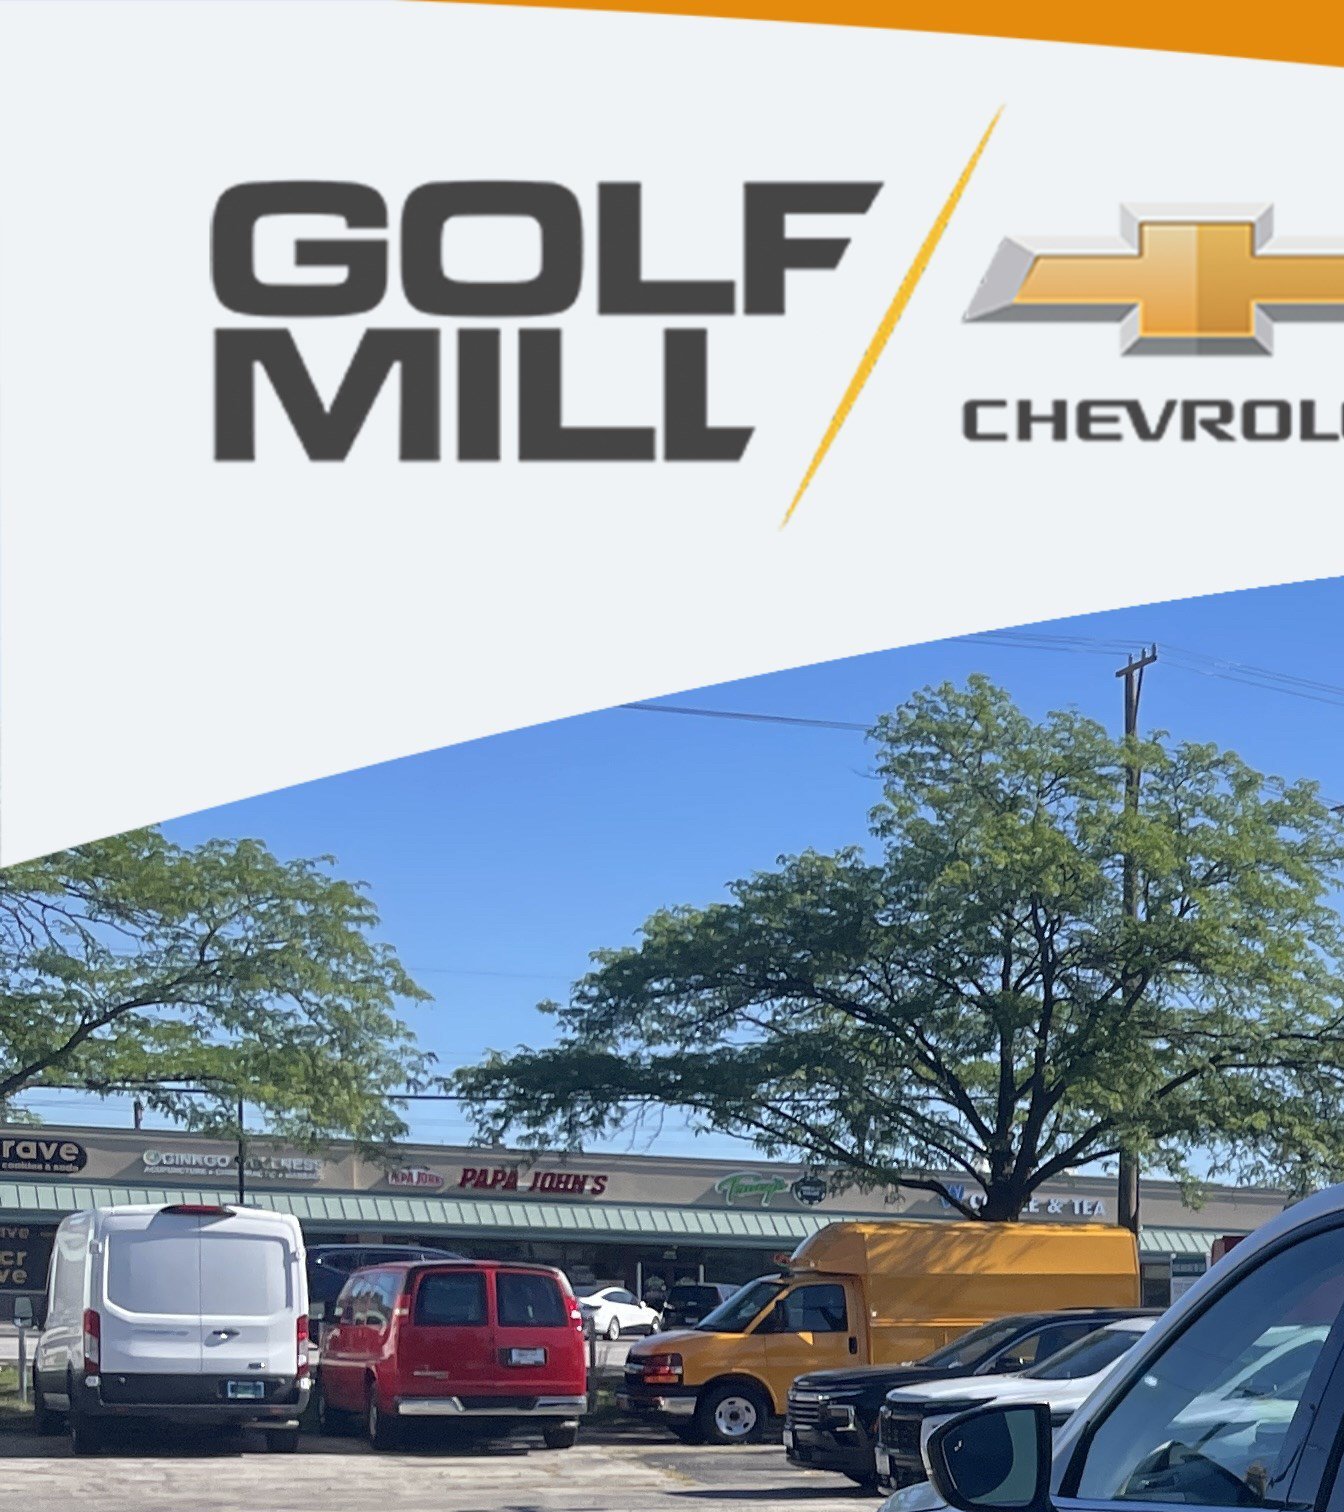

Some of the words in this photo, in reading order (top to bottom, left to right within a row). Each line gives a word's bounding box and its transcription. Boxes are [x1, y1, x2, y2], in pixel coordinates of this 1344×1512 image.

[459, 1167, 519, 1190] PAPA
[528, 1170, 609, 1195] JOHN'S
[1071, 1199, 1106, 1216] TEA
